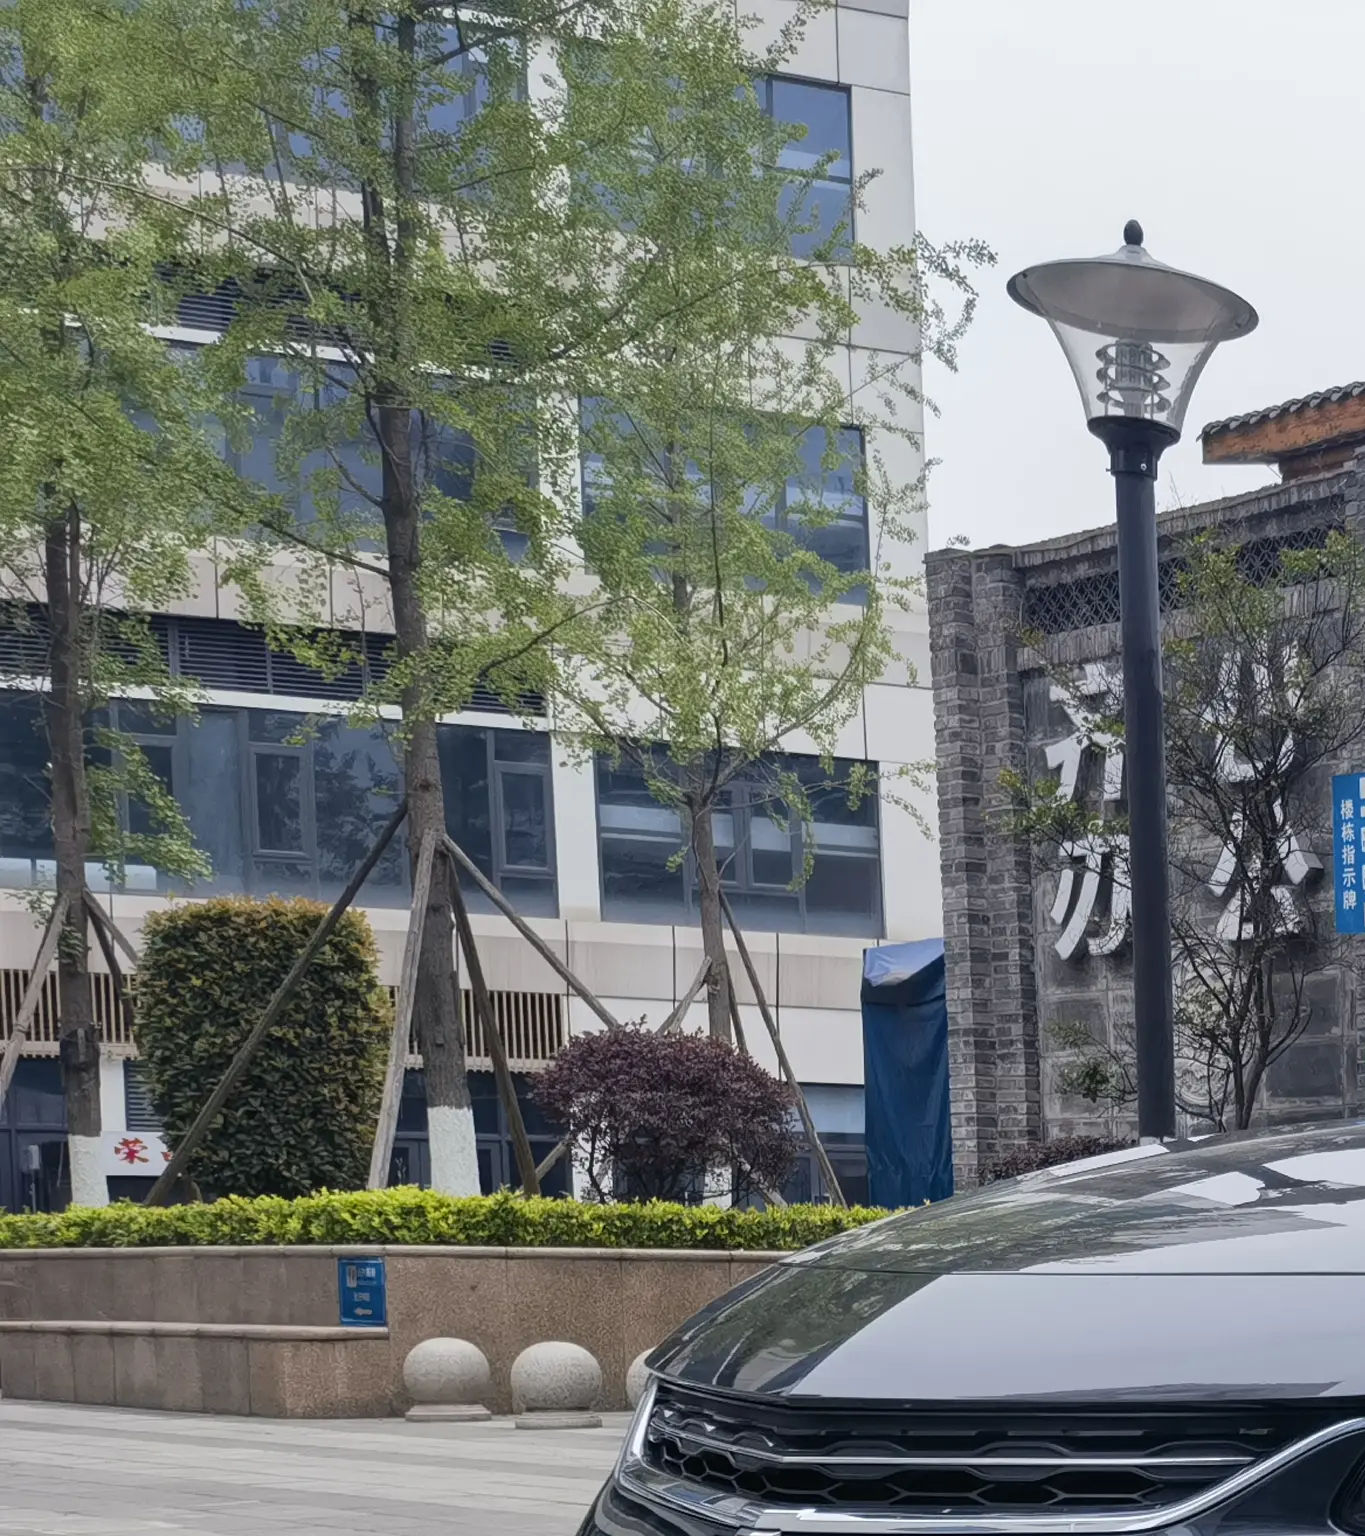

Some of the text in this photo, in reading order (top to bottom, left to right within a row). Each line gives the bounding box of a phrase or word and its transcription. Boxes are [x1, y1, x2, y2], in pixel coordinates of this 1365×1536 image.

[1340, 799, 1358, 911] 楼栋指示牌
